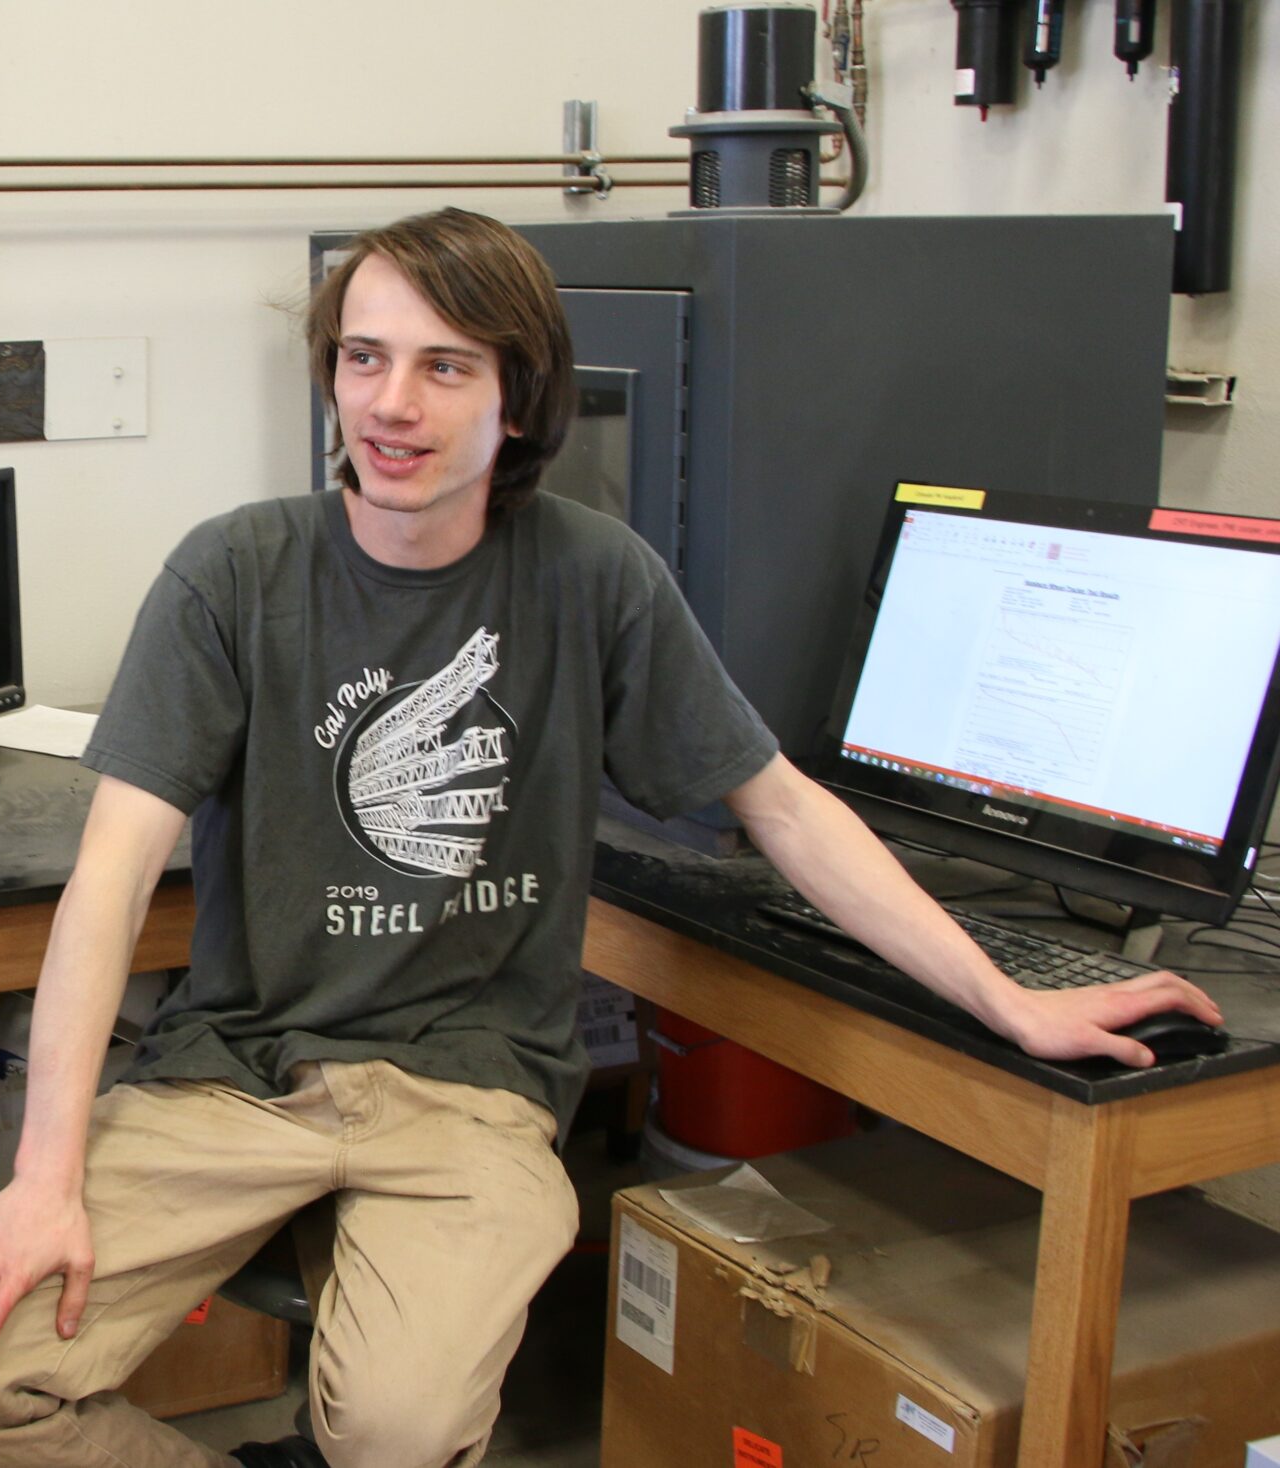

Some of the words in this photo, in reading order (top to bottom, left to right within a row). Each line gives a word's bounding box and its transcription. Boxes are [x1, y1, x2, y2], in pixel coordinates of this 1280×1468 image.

[314, 702, 347, 749] Cal
[337, 667, 394, 709] Poly
[326, 885, 379, 901] 2019
[326, 902, 423, 936] STEEL
